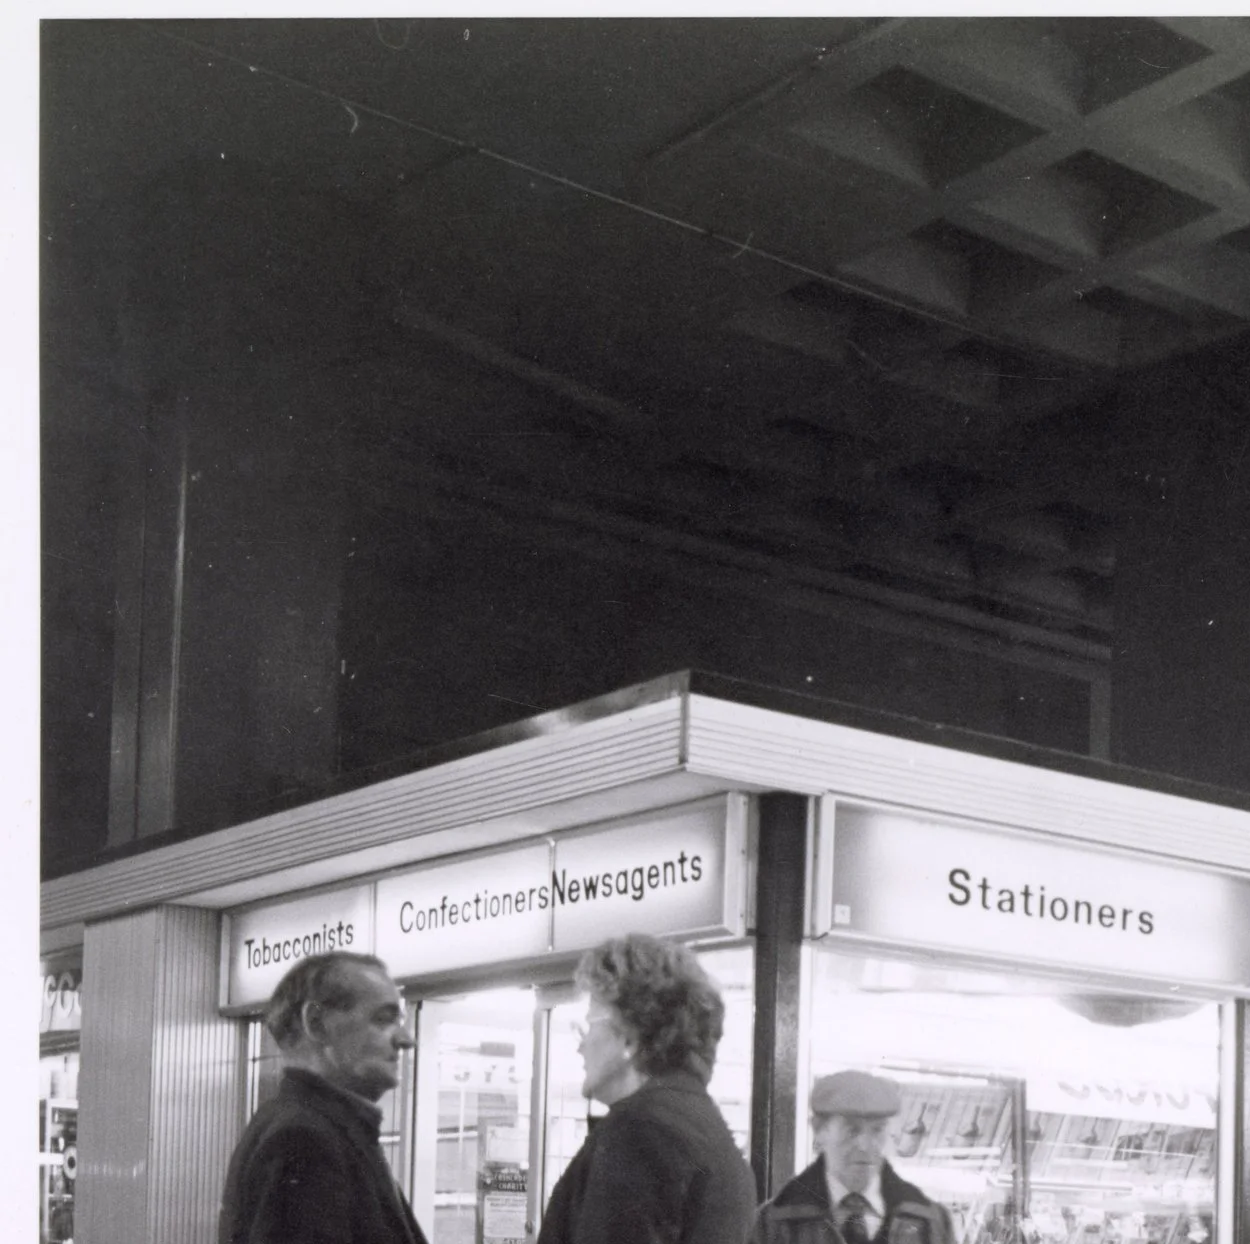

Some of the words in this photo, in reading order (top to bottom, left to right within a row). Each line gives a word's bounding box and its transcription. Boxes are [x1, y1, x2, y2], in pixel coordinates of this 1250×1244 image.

[551, 851, 703, 907] Newsagents
[947, 868, 1155, 936] Stationers
[399, 885, 549, 934] Confectioners
[244, 920, 355, 970] Tobacconists
